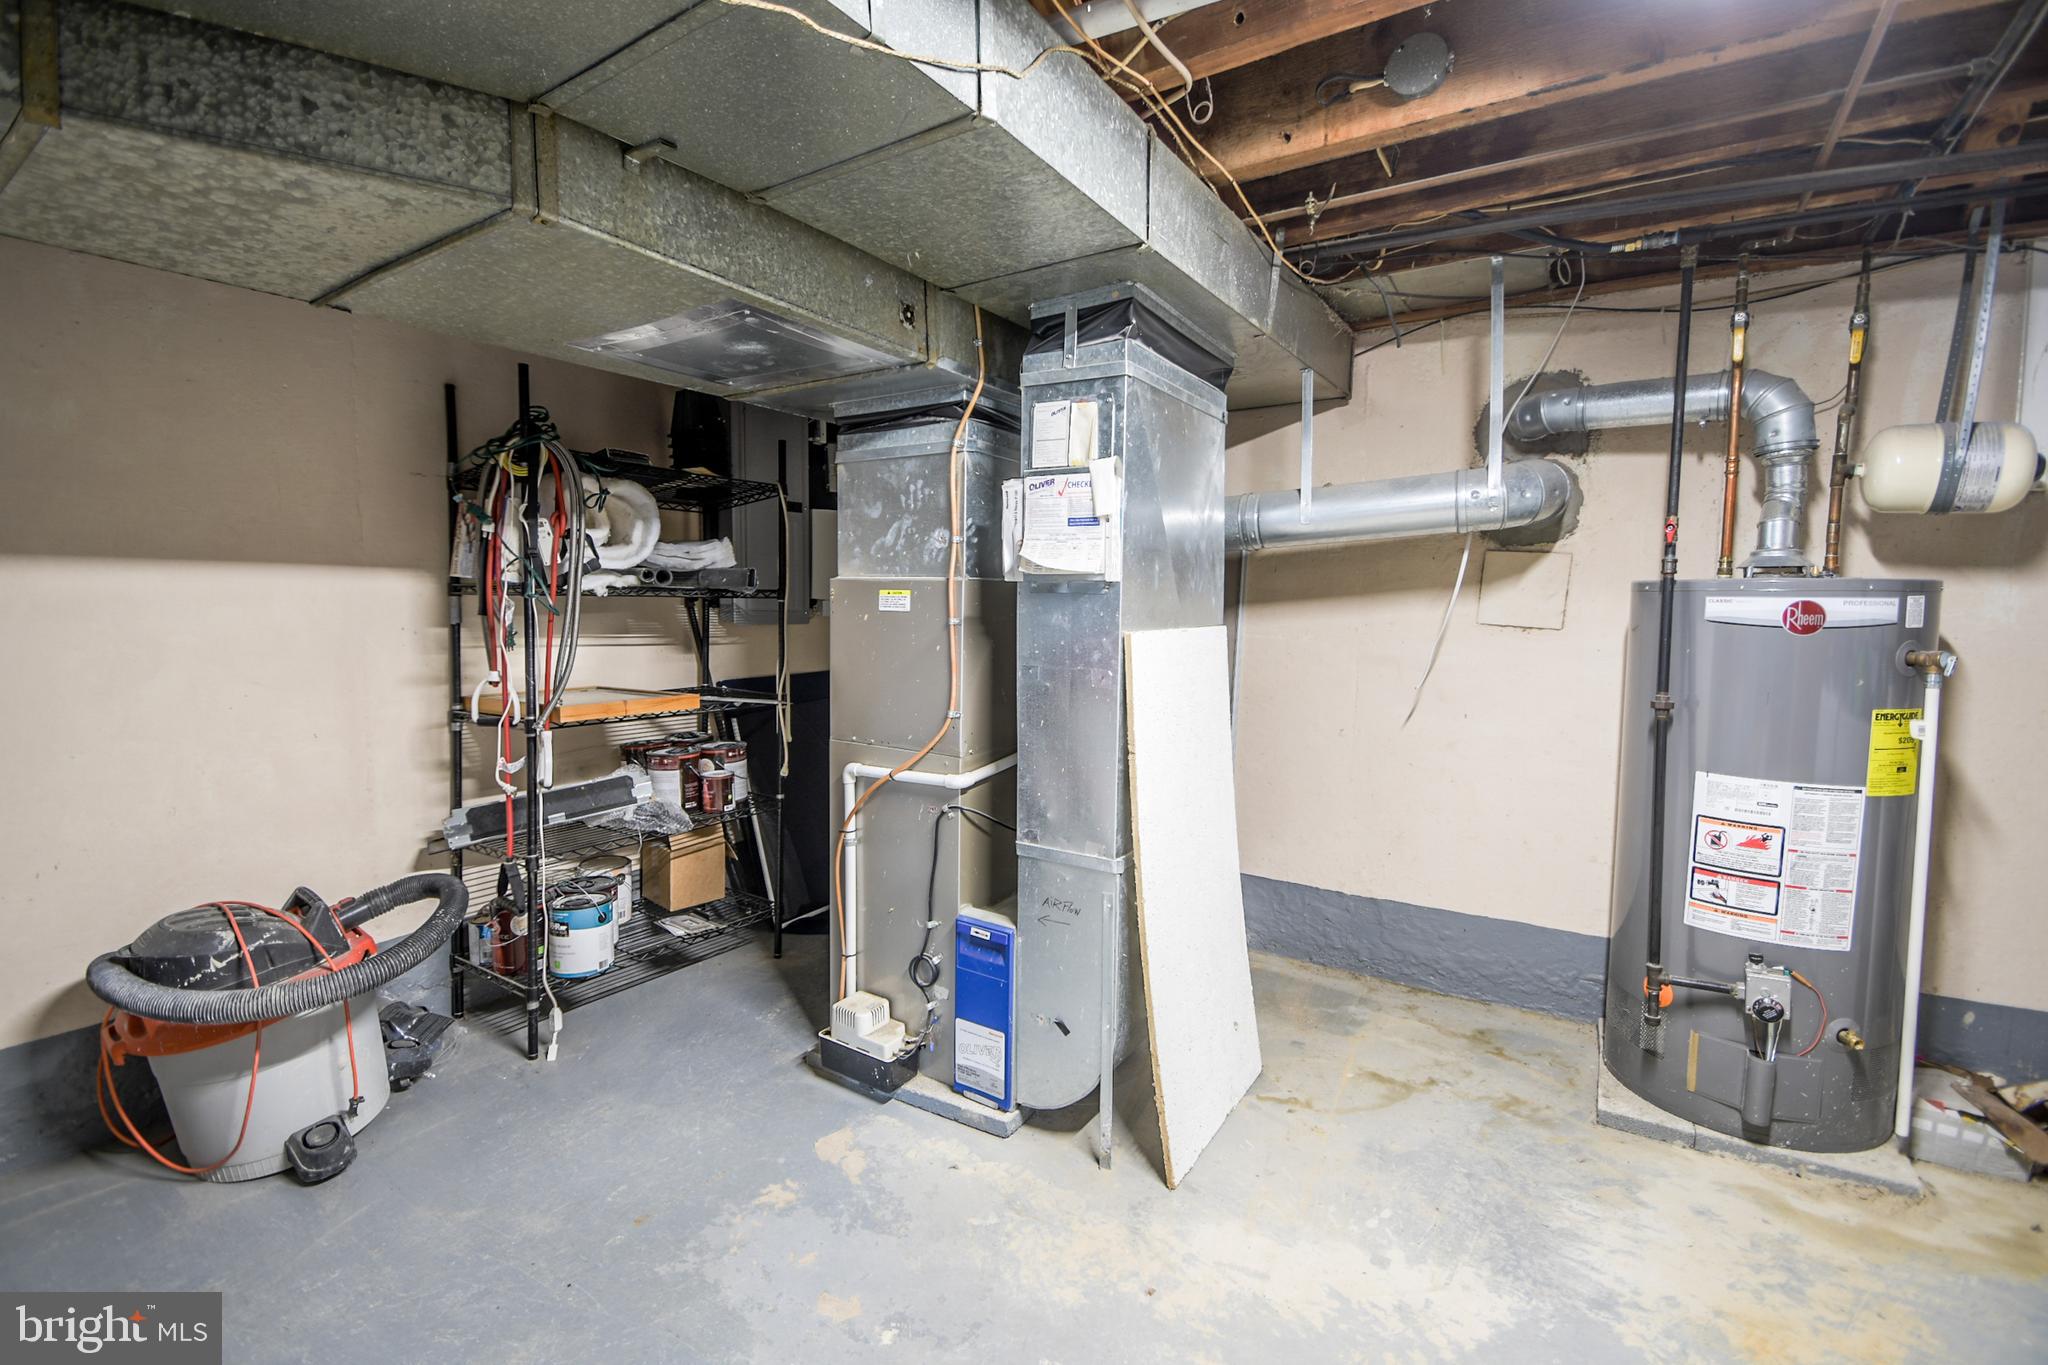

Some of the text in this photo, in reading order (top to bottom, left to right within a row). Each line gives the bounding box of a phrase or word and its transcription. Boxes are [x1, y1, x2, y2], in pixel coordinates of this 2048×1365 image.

[1029, 478, 1056, 491] OLIVER
[1843, 599, 1897, 607] PROFESSIONAL
[1786, 606, 1824, 630] Rheem
